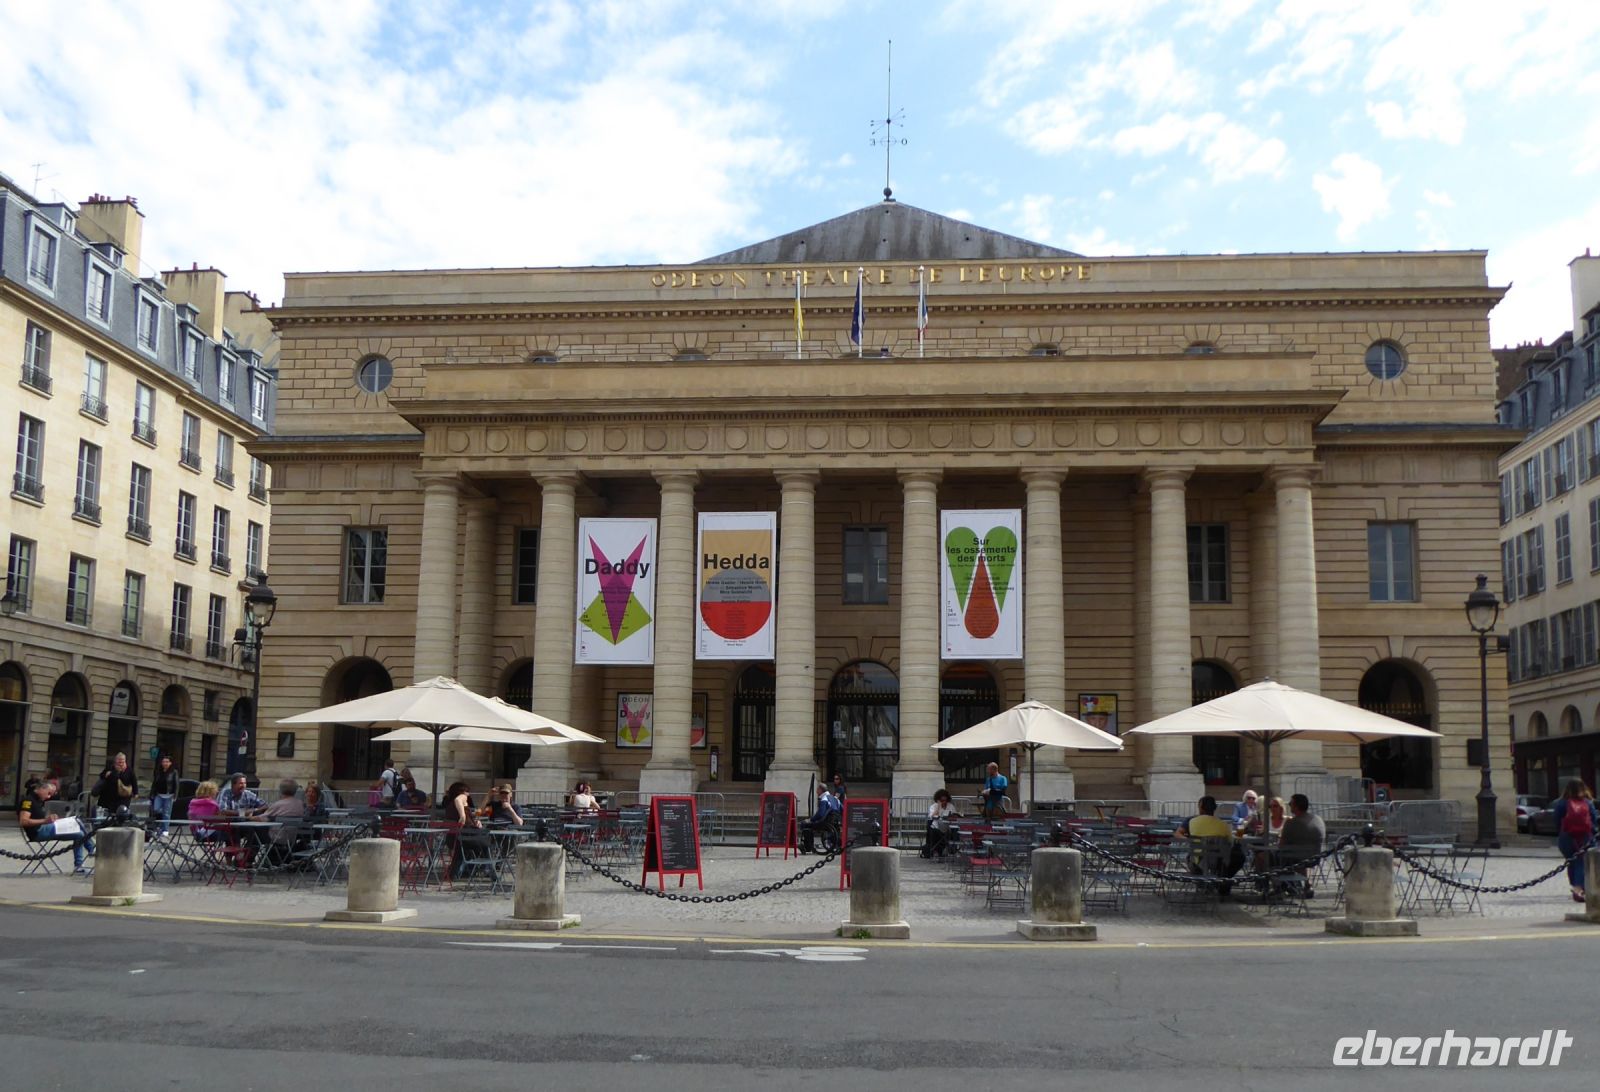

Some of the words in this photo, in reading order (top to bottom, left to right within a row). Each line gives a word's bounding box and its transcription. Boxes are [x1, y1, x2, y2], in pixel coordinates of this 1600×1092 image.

[651, 271, 747, 288] ODEON
[761, 268, 893, 287] THEATRE
[909, 267, 943, 284] DE
[959, 264, 1091, 283] L'EUROPE
[973, 537, 990, 546] Sur
[947, 546, 961, 554] les
[963, 546, 1017, 554] ossements
[703, 553, 769, 569] Hedda
[957, 554, 975, 562] des
[977, 554, 1006, 562] morts
[585, 558, 650, 579] Daddy
[620, 709, 651, 720] Daddy
